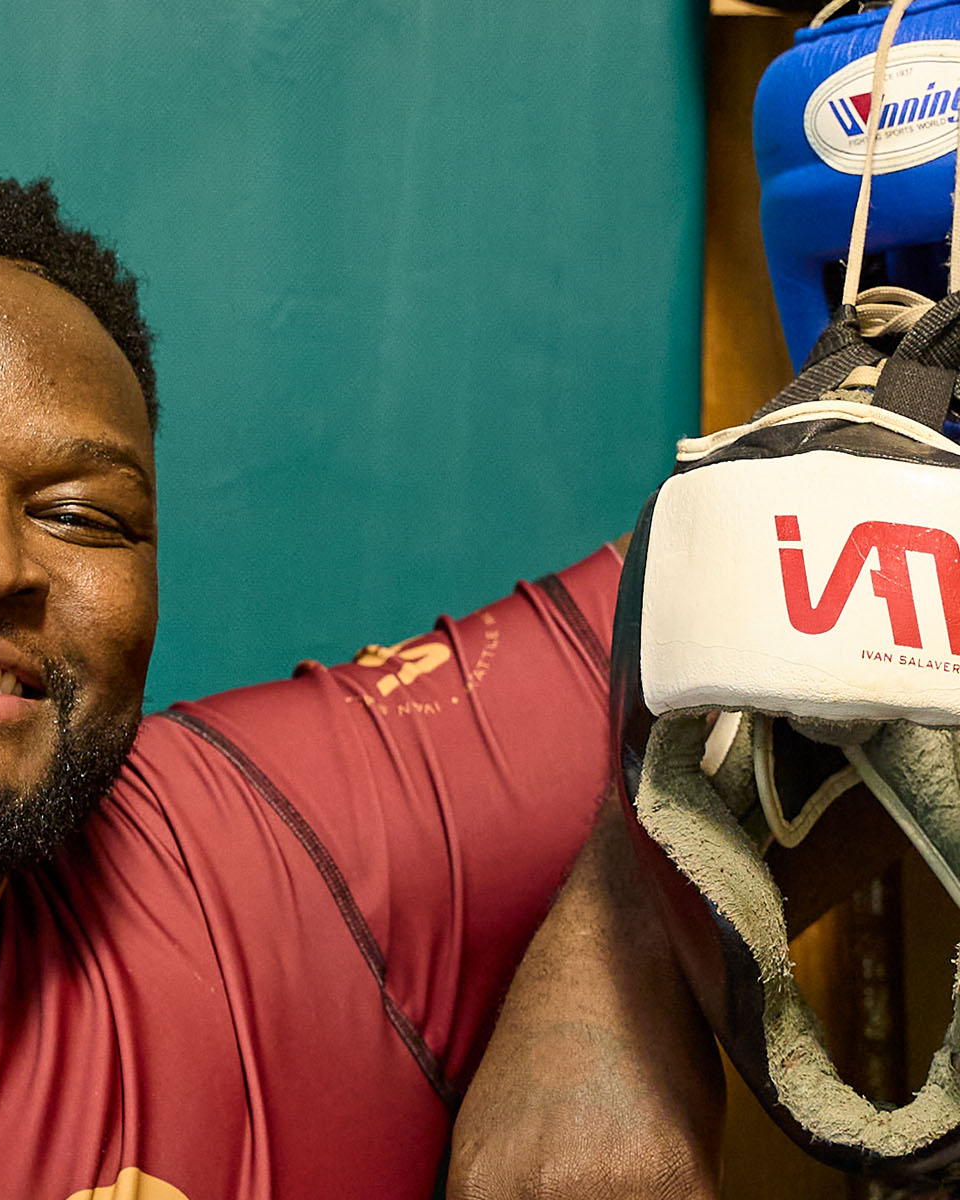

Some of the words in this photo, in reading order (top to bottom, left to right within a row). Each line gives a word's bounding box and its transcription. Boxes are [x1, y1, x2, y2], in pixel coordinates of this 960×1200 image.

[885, 125, 914, 139] SPORTS
[917, 117, 946, 132] WORLD
[861, 649, 893, 663] IVAN
